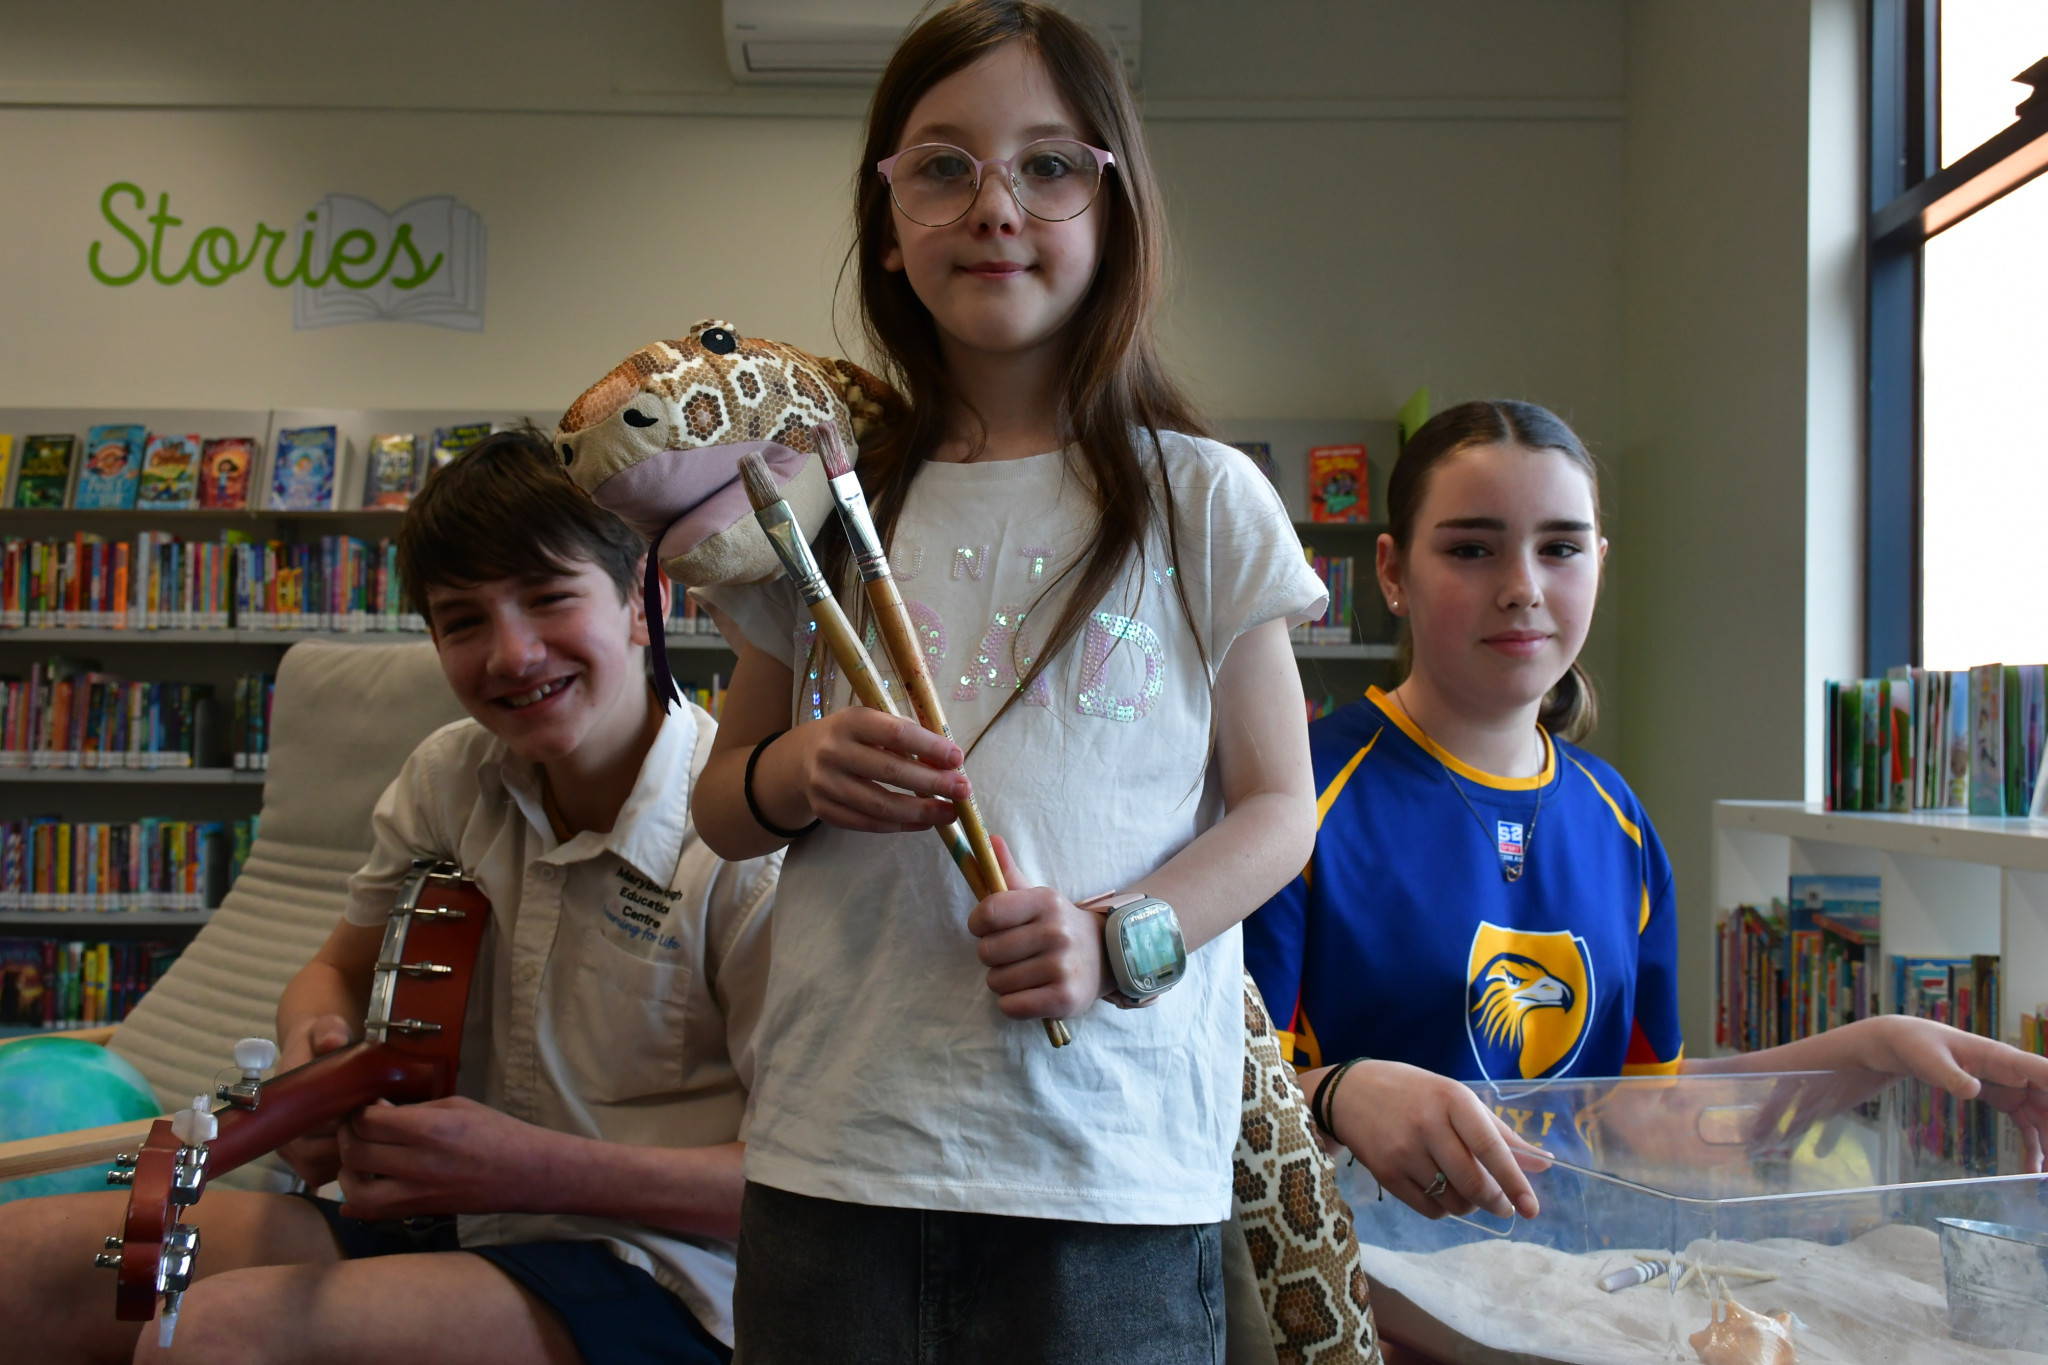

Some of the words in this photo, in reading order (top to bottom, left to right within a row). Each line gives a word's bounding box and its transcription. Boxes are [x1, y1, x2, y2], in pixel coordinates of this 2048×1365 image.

[88, 181, 444, 289] Stories
[1499, 825, 1522, 842] S2
[622, 905, 661, 929] Centre
